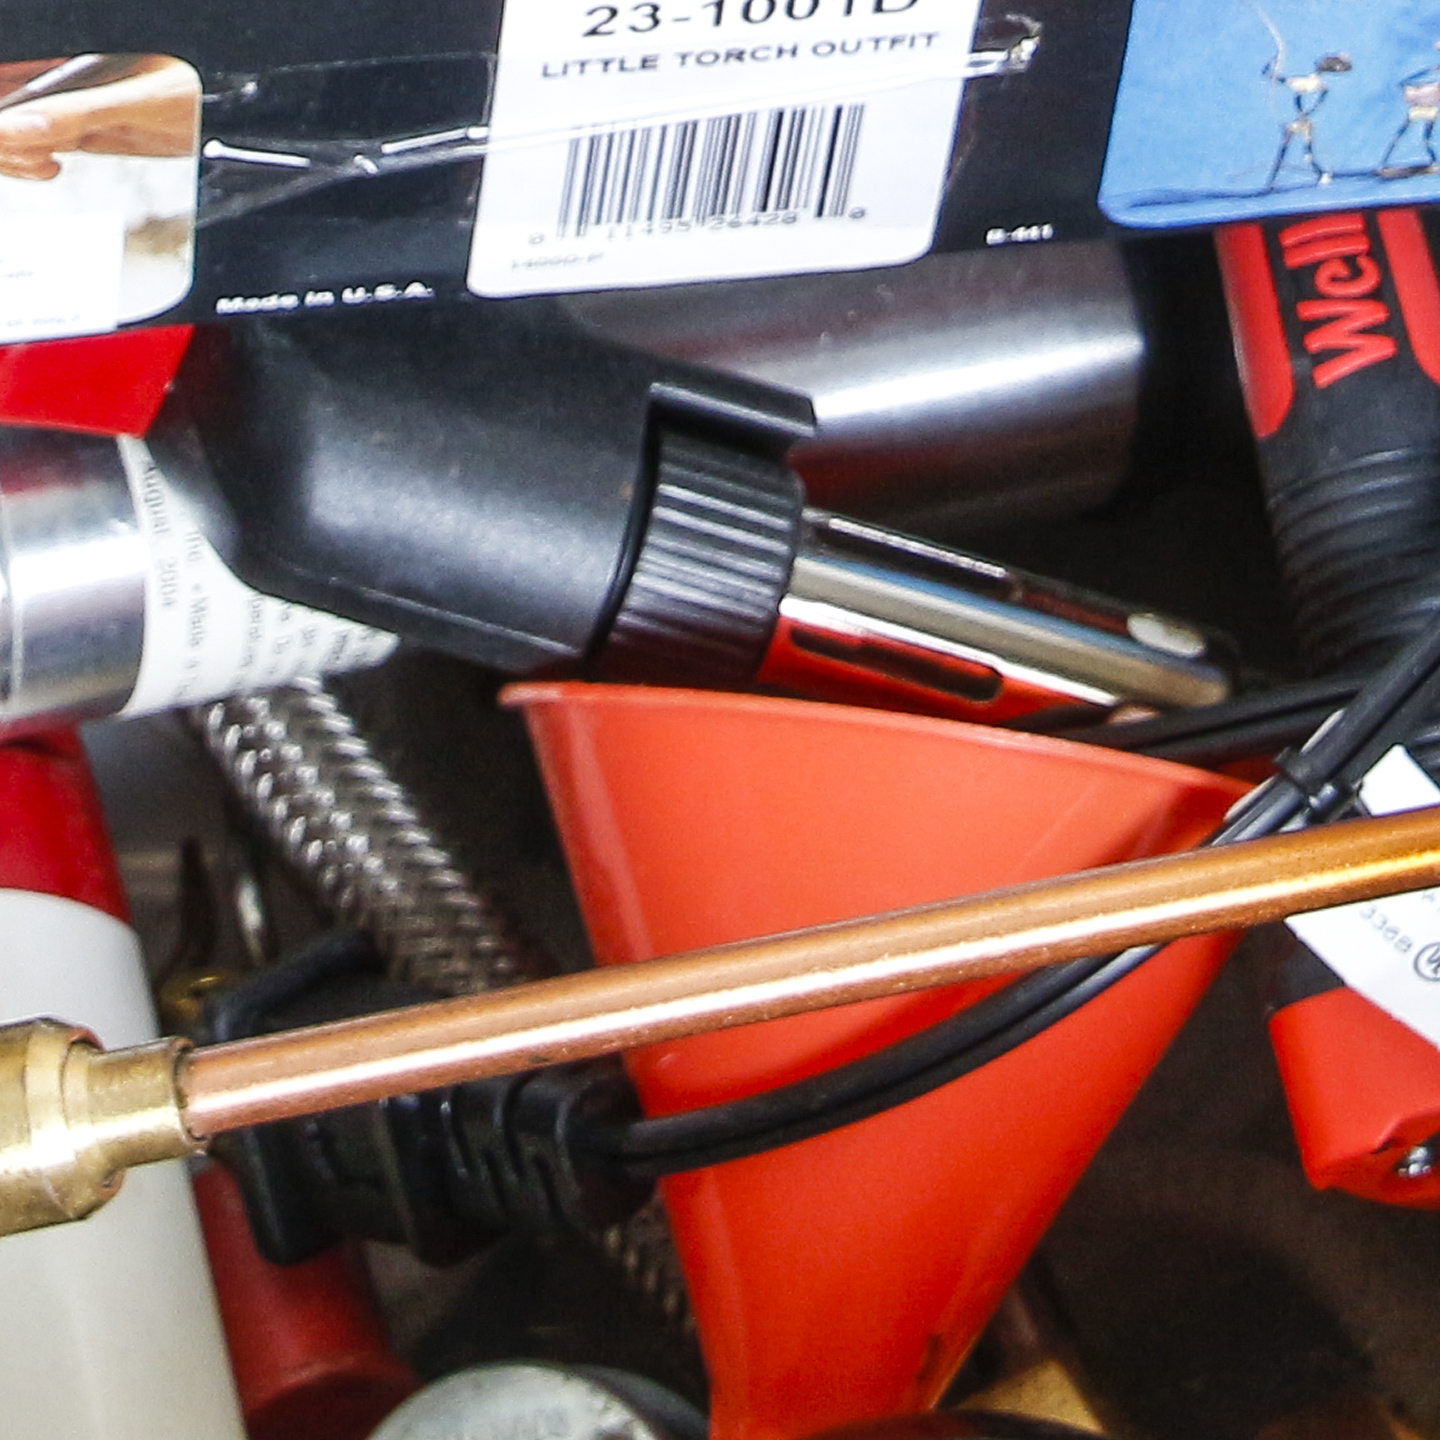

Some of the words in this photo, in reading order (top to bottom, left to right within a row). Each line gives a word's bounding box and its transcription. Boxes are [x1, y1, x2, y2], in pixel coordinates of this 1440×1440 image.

[541, 53, 658, 78] LITTLE
[675, 44, 798, 67] TORCH
[811, 33, 939, 56] OUTFIT
[215, 291, 298, 314] Made
[1277, 209, 1402, 391] Well
